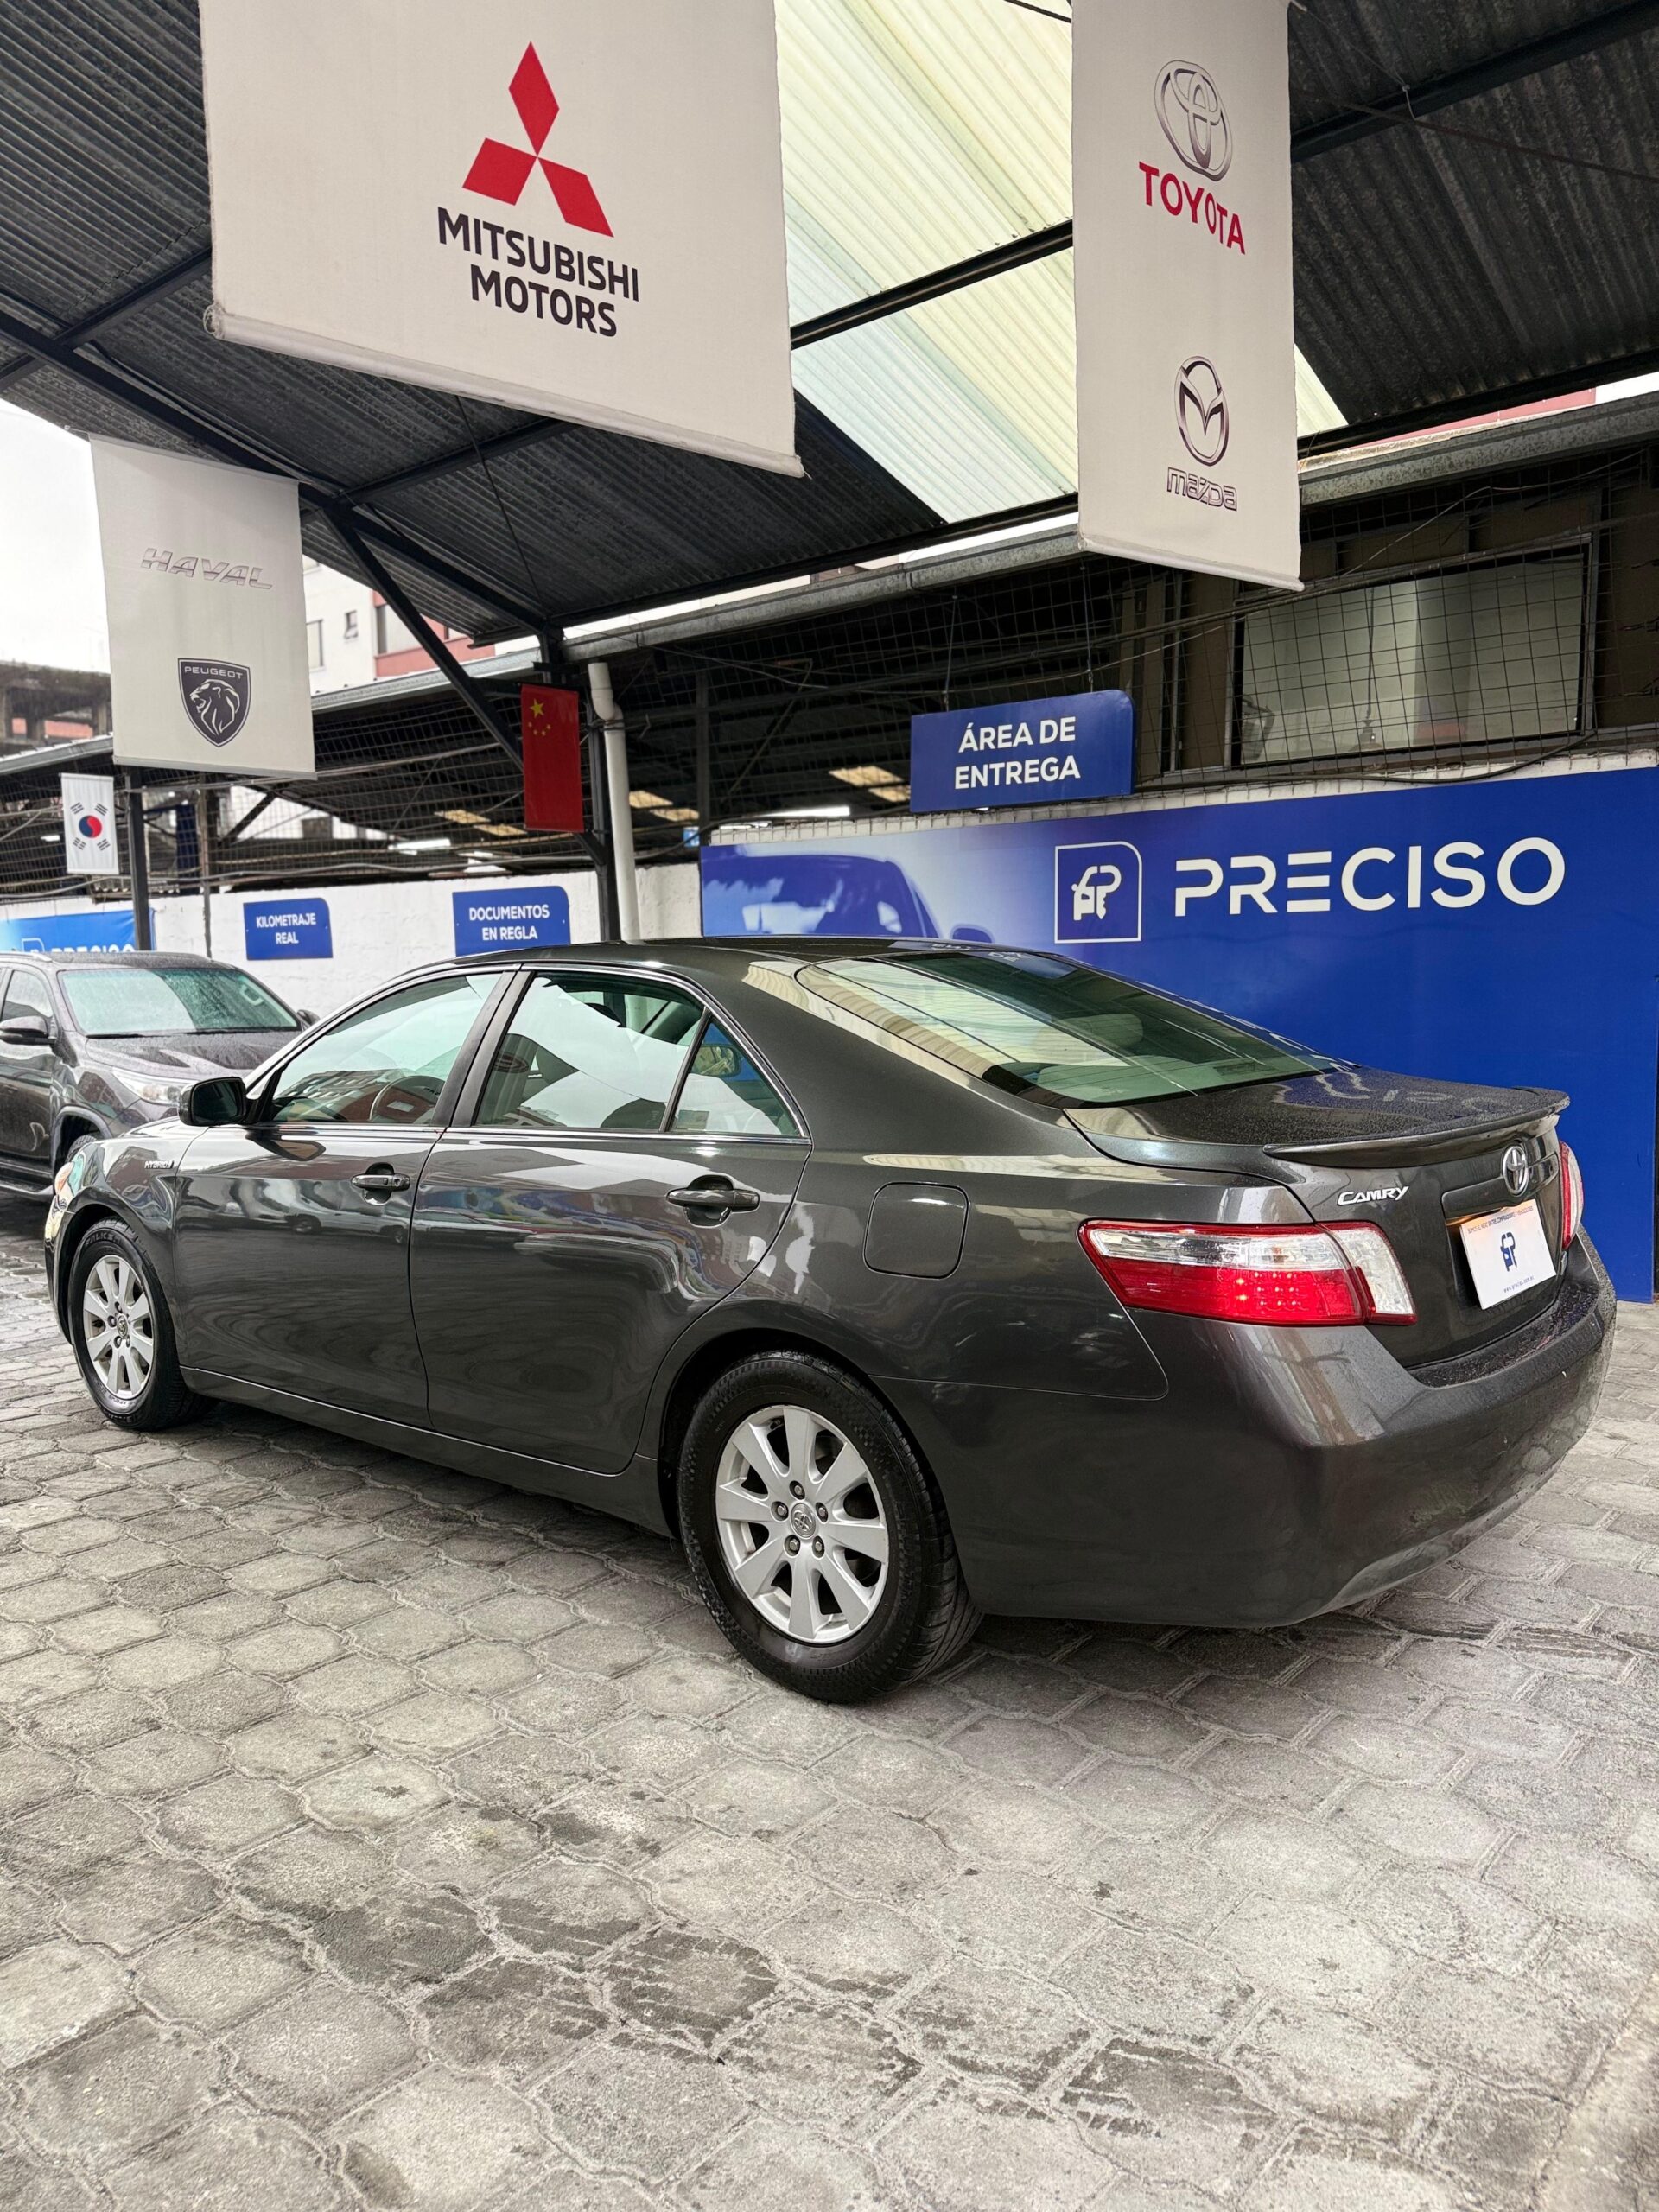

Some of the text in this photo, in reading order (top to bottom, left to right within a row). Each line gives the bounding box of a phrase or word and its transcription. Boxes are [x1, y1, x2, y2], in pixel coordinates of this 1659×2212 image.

[1139, 161, 1246, 255] TOYOTA
[437, 206, 639, 302] MITSUBISHI
[470, 263, 617, 337] MOTORS
[140, 547, 273, 589] HAVAL
[184, 665, 244, 680] PEUGEOT
[958, 716, 1076, 753] ÁREA DE
[955, 755, 1081, 789] ENTREGA
[1174, 836, 1566, 917] PRECISO
[256, 912, 317, 928] KILOMETRAJE
[468, 904, 550, 921] DOCUMENTOS
[275, 931, 299, 944] REAL
[482, 925, 537, 941] EN REGLA
[1338, 1185, 1409, 1205] CAMRY
